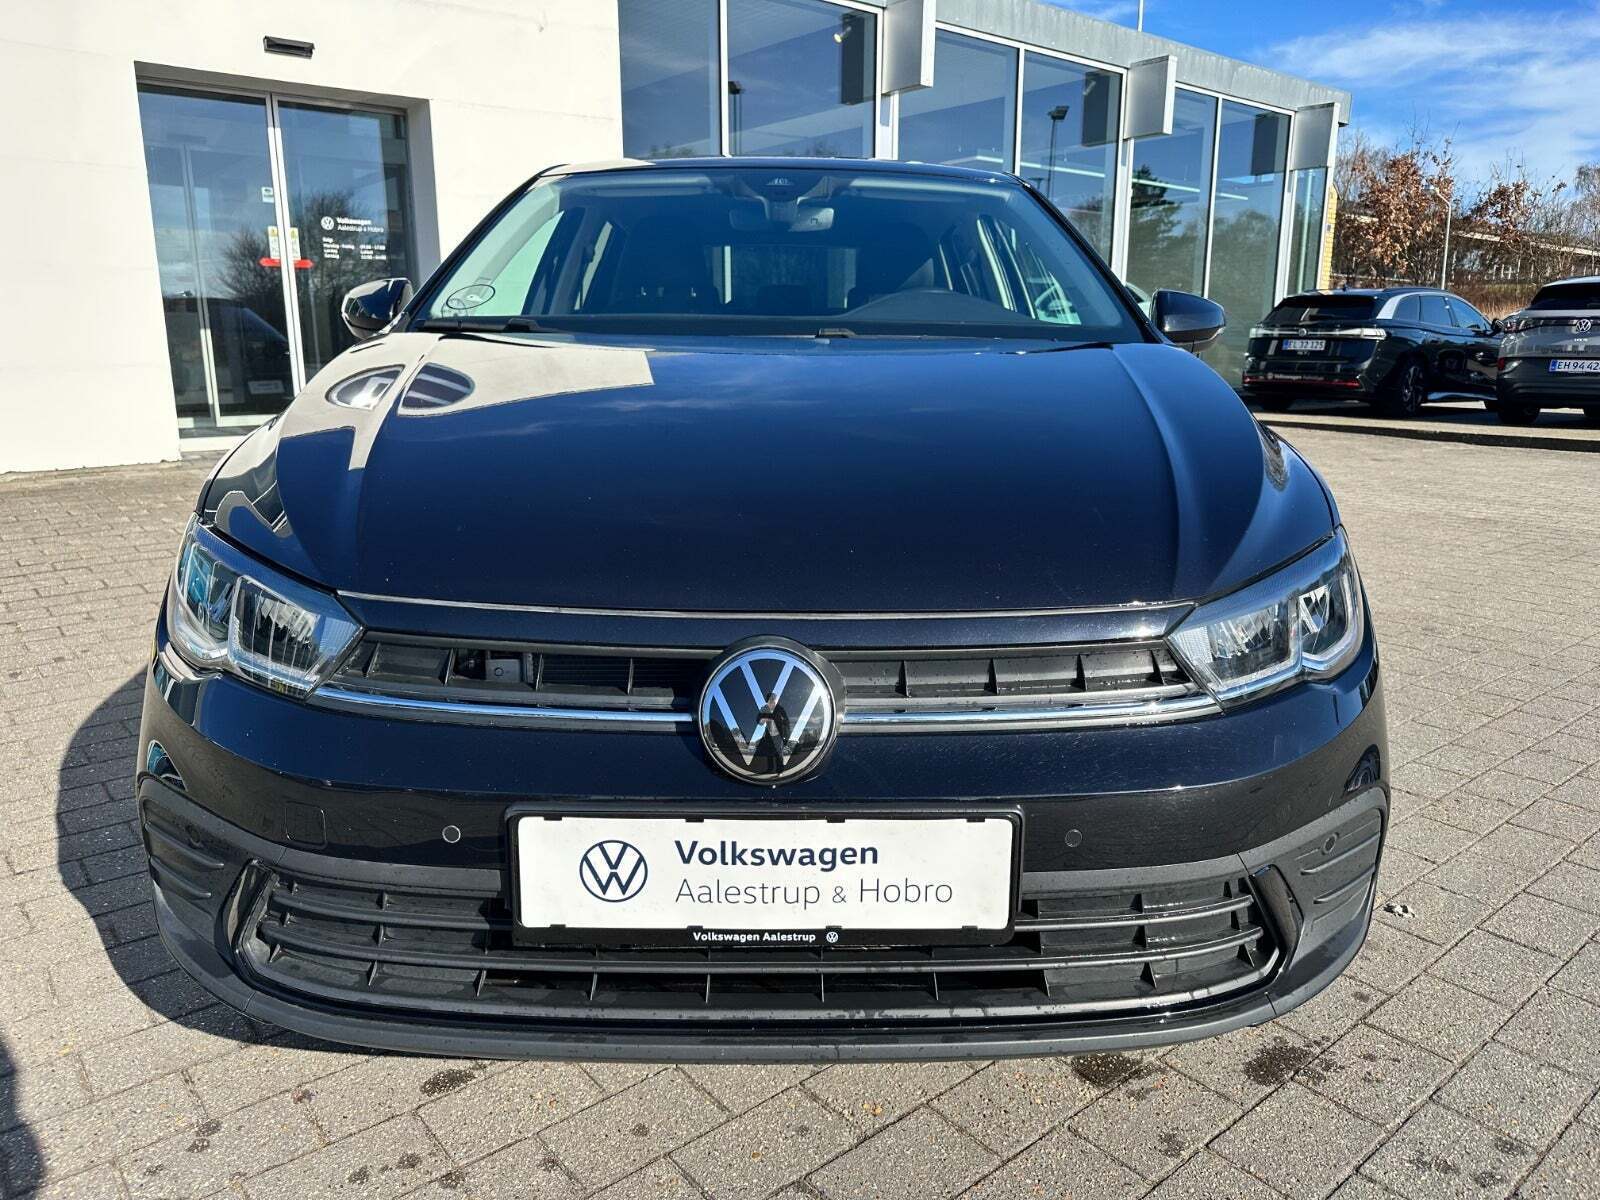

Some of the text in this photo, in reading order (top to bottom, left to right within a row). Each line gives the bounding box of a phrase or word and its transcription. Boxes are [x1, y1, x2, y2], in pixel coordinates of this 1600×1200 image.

[1557, 361, 1600, 370] EH 94 42
[674, 840, 879, 872] Volkswagen
[675, 877, 953, 910] Aalestrup & Hobro
[692, 931, 760, 943] Volkswagen
[762, 932, 816, 943] Aalestrup
